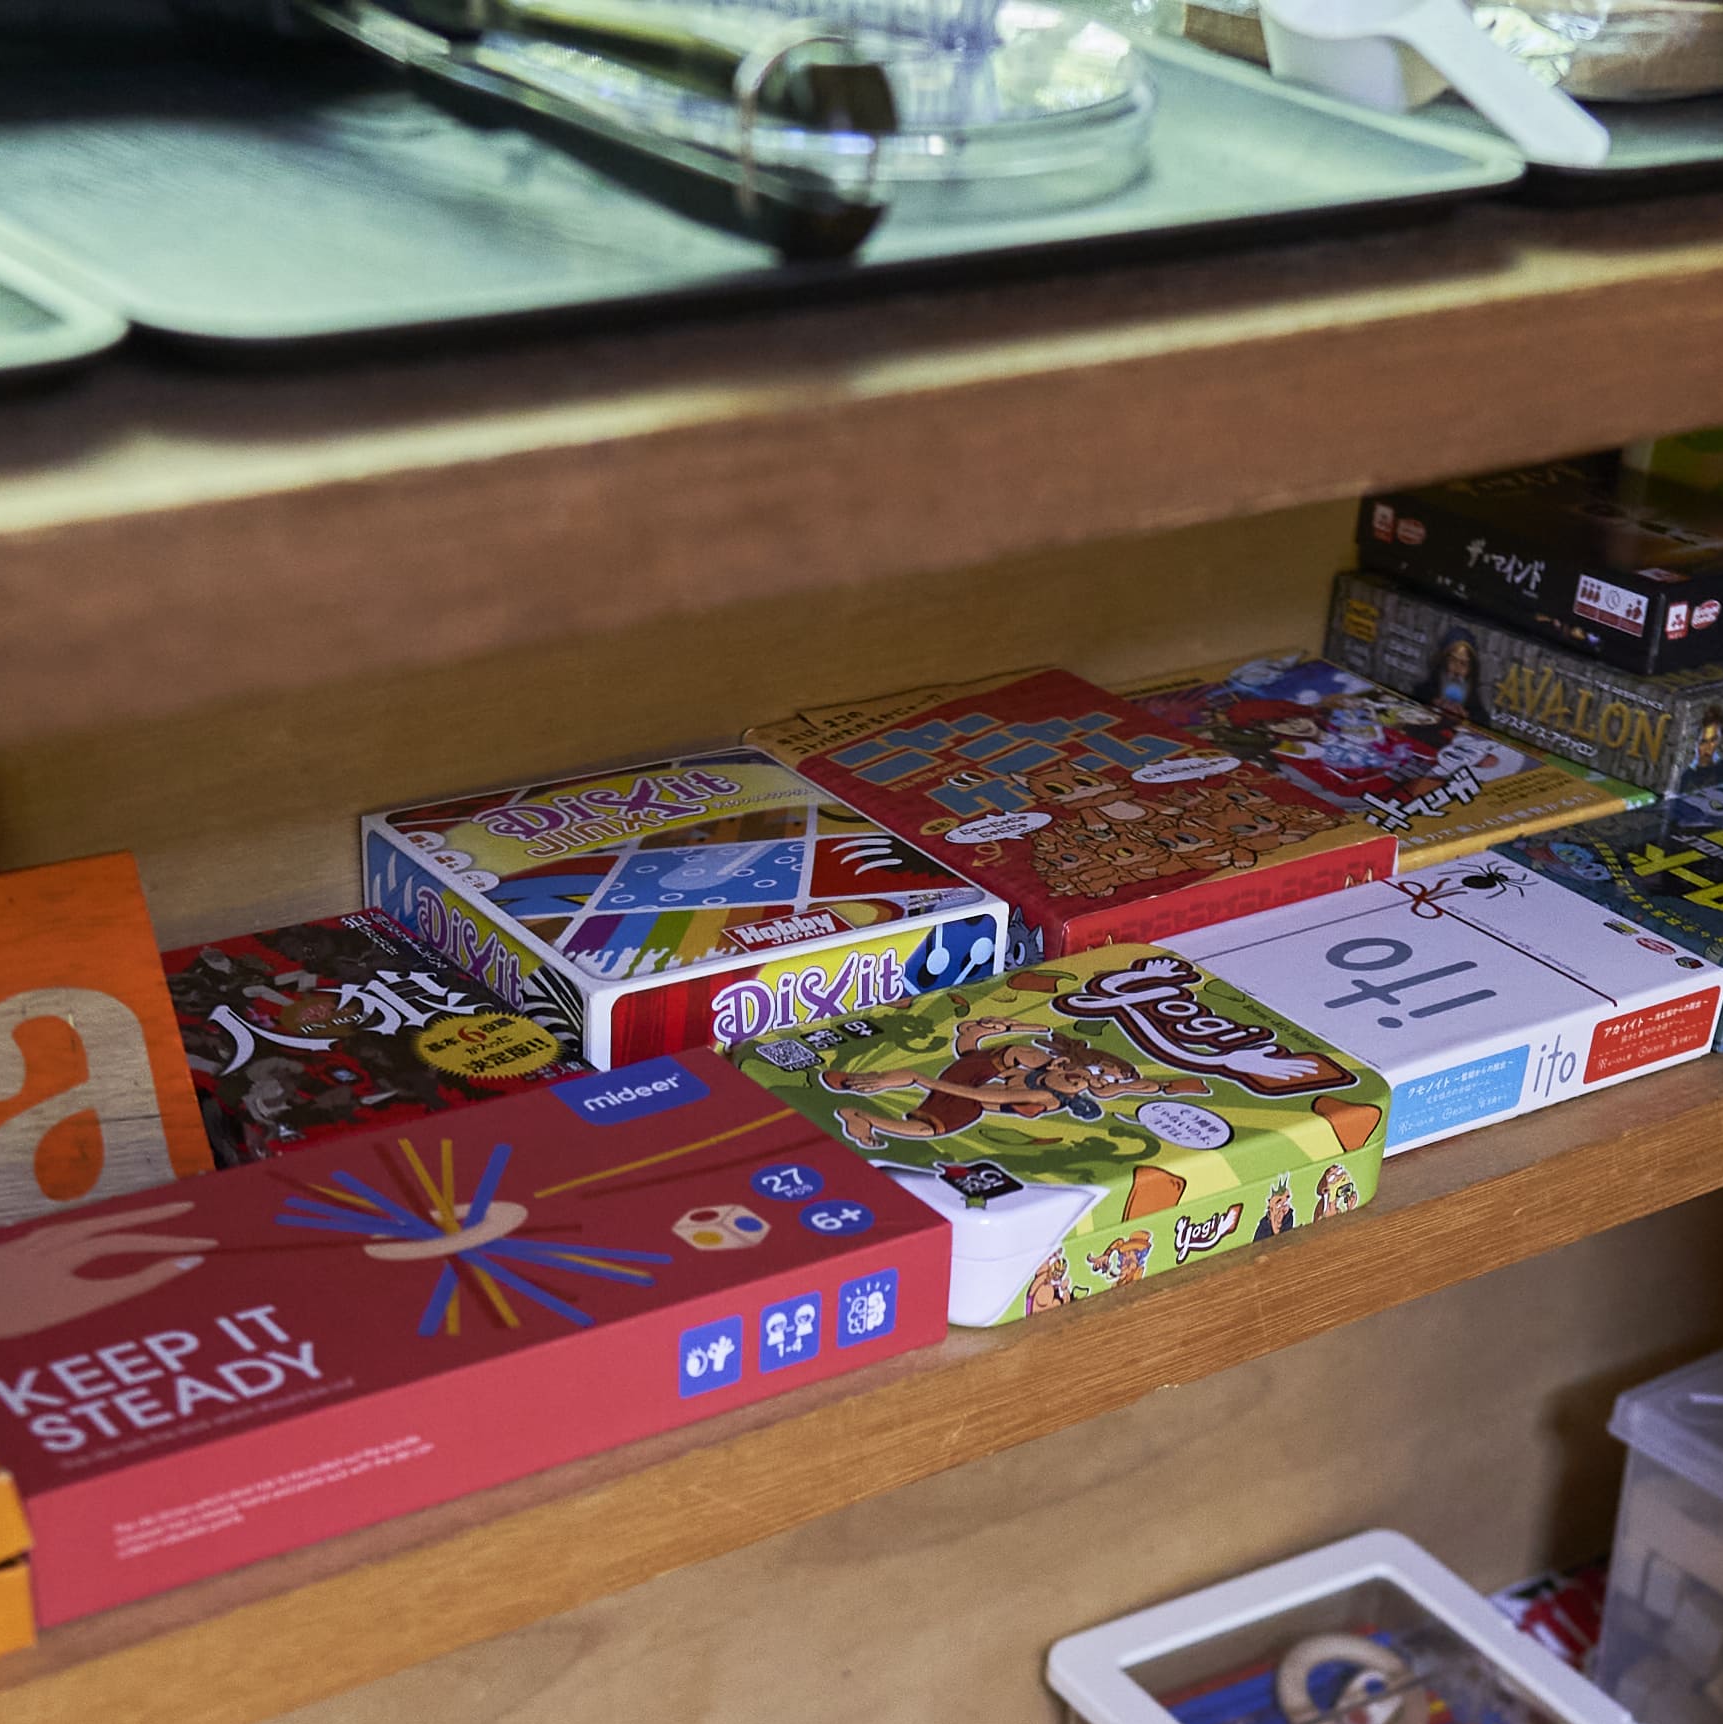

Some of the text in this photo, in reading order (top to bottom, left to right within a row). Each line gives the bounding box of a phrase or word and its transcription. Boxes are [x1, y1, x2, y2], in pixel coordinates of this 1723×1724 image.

[1494, 662, 1672, 766] AVALON
[732, 911, 838, 947] Hobby
[771, 928, 829, 947] JAPAN
[712, 946, 906, 1043] Dixit
[1323, 936, 1497, 1029] ito
[208, 970, 494, 1076] 人狼
[1534, 1033, 1577, 1098] ito
[582, 1071, 681, 1113] mideer
[761, 1168, 804, 1195] 27
[810, 1205, 863, 1232] 6+
[215, 1304, 292, 1353] IT
[776, 1339, 804, 1360] 1-4
[28, 1341, 323, 1453] STEADY
